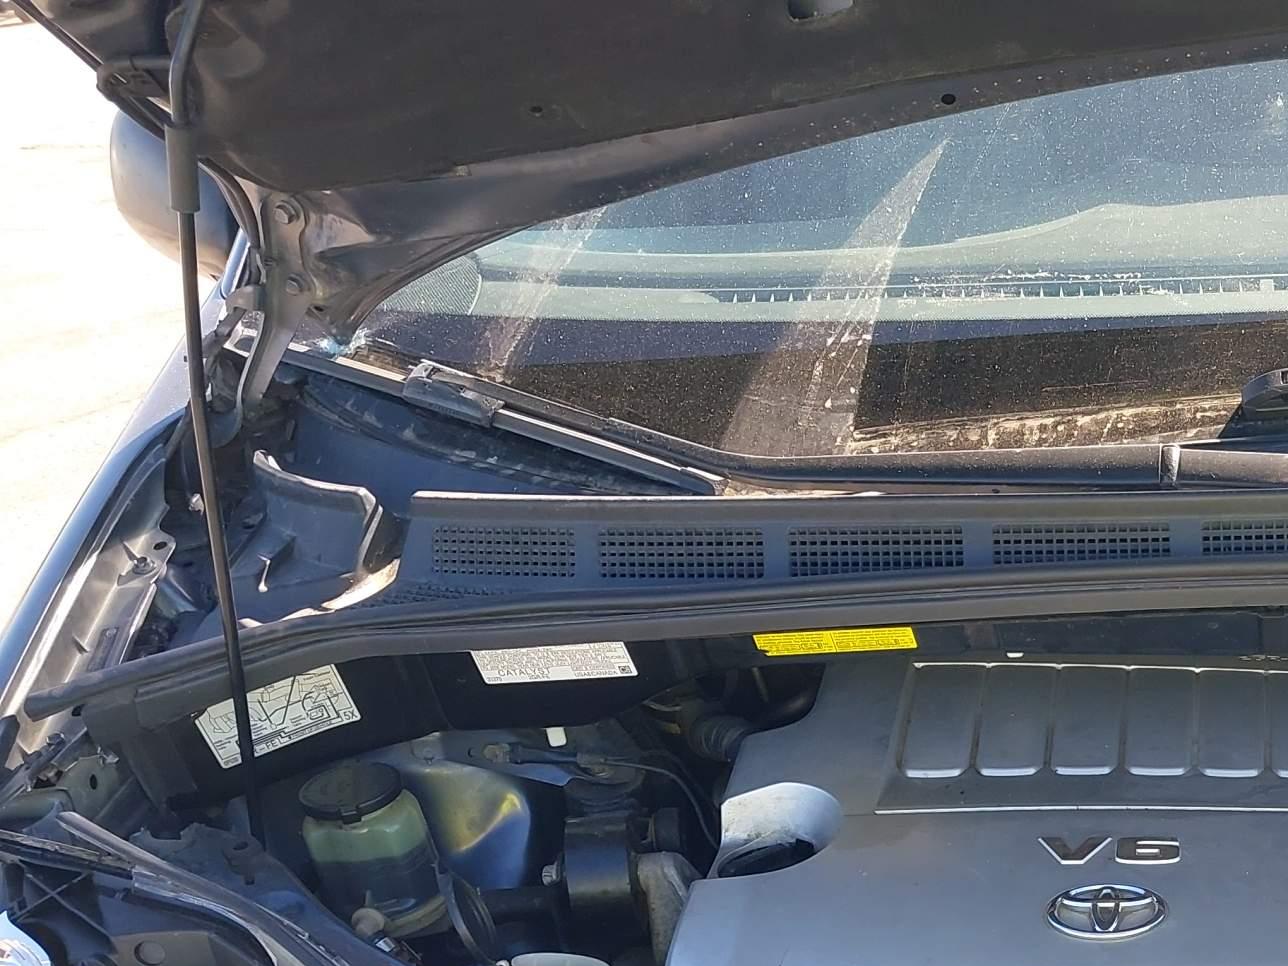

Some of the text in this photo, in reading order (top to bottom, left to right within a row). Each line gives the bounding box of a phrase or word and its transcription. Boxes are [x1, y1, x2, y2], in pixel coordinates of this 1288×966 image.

[497, 667, 551, 677] CATALYST
[343, 709, 358, 721] 5X
[1038, 837, 1181, 865] V6
